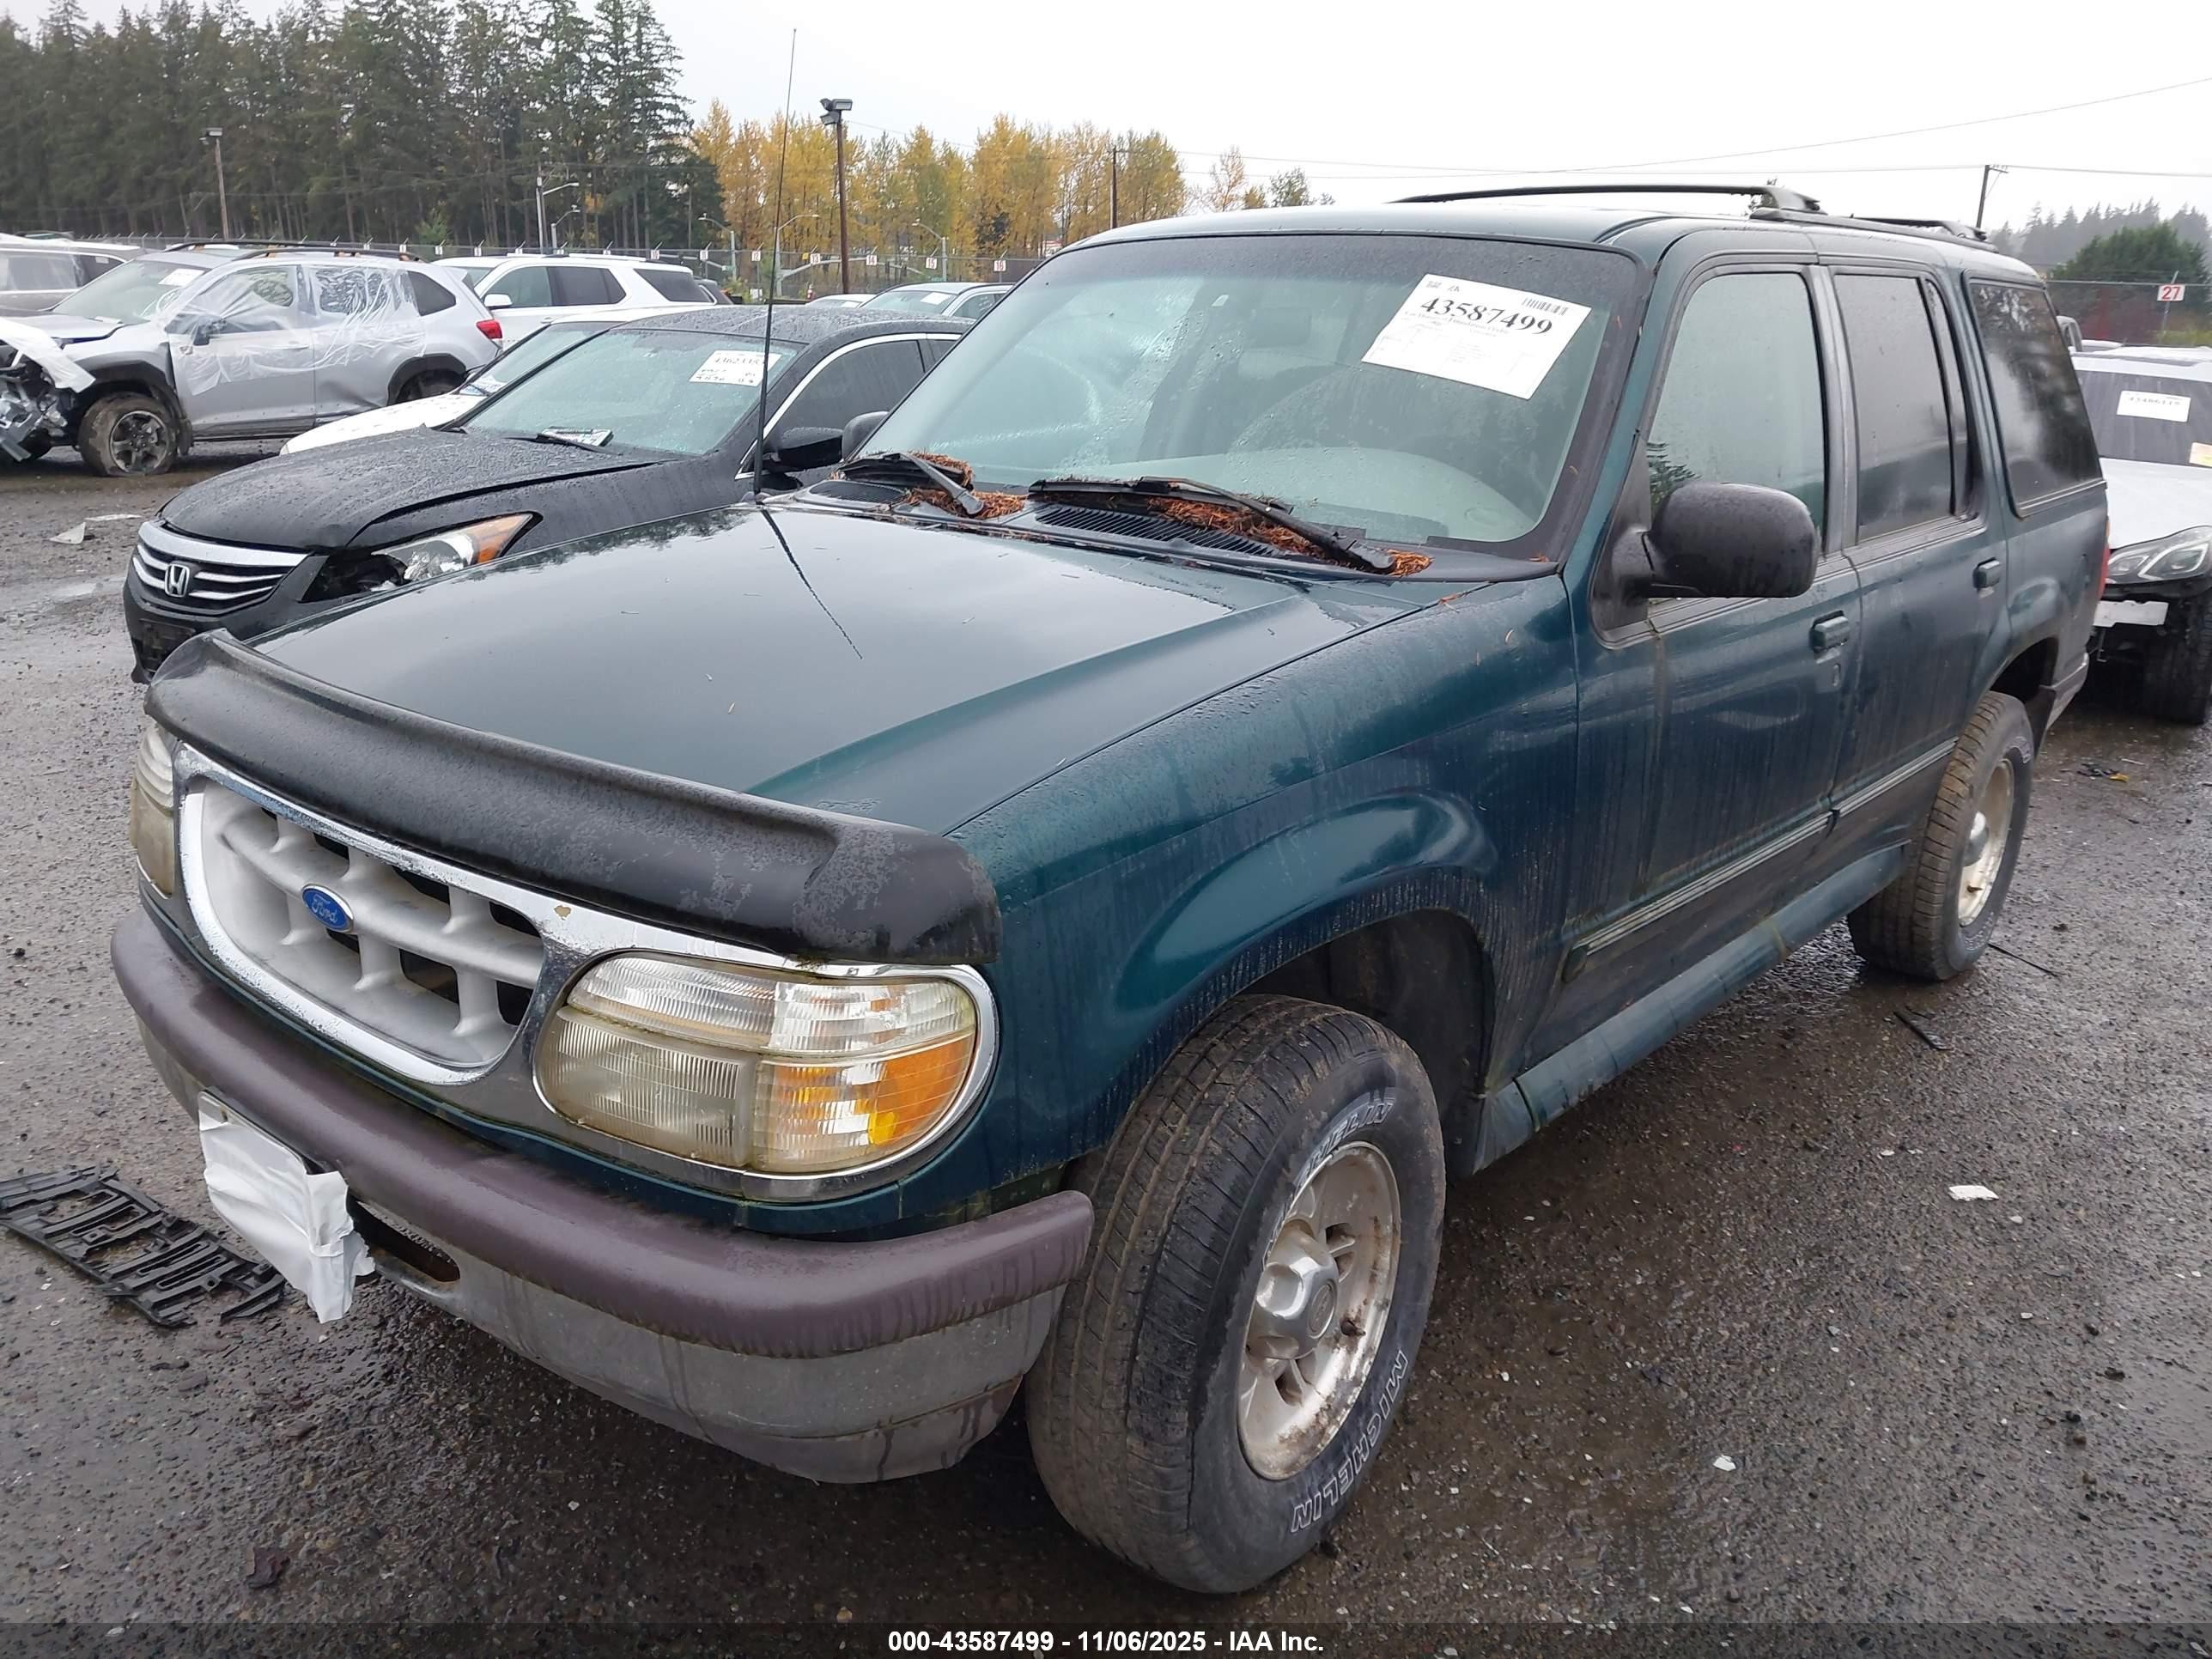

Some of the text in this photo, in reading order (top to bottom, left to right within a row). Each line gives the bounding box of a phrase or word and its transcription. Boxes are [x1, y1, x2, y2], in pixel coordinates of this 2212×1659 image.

[2162, 286, 2181, 300] 27
[1420, 297, 1553, 335] 43587499
[311, 893, 338, 924] Ford
[1291, 1349, 1408, 1533] MICHELIN
